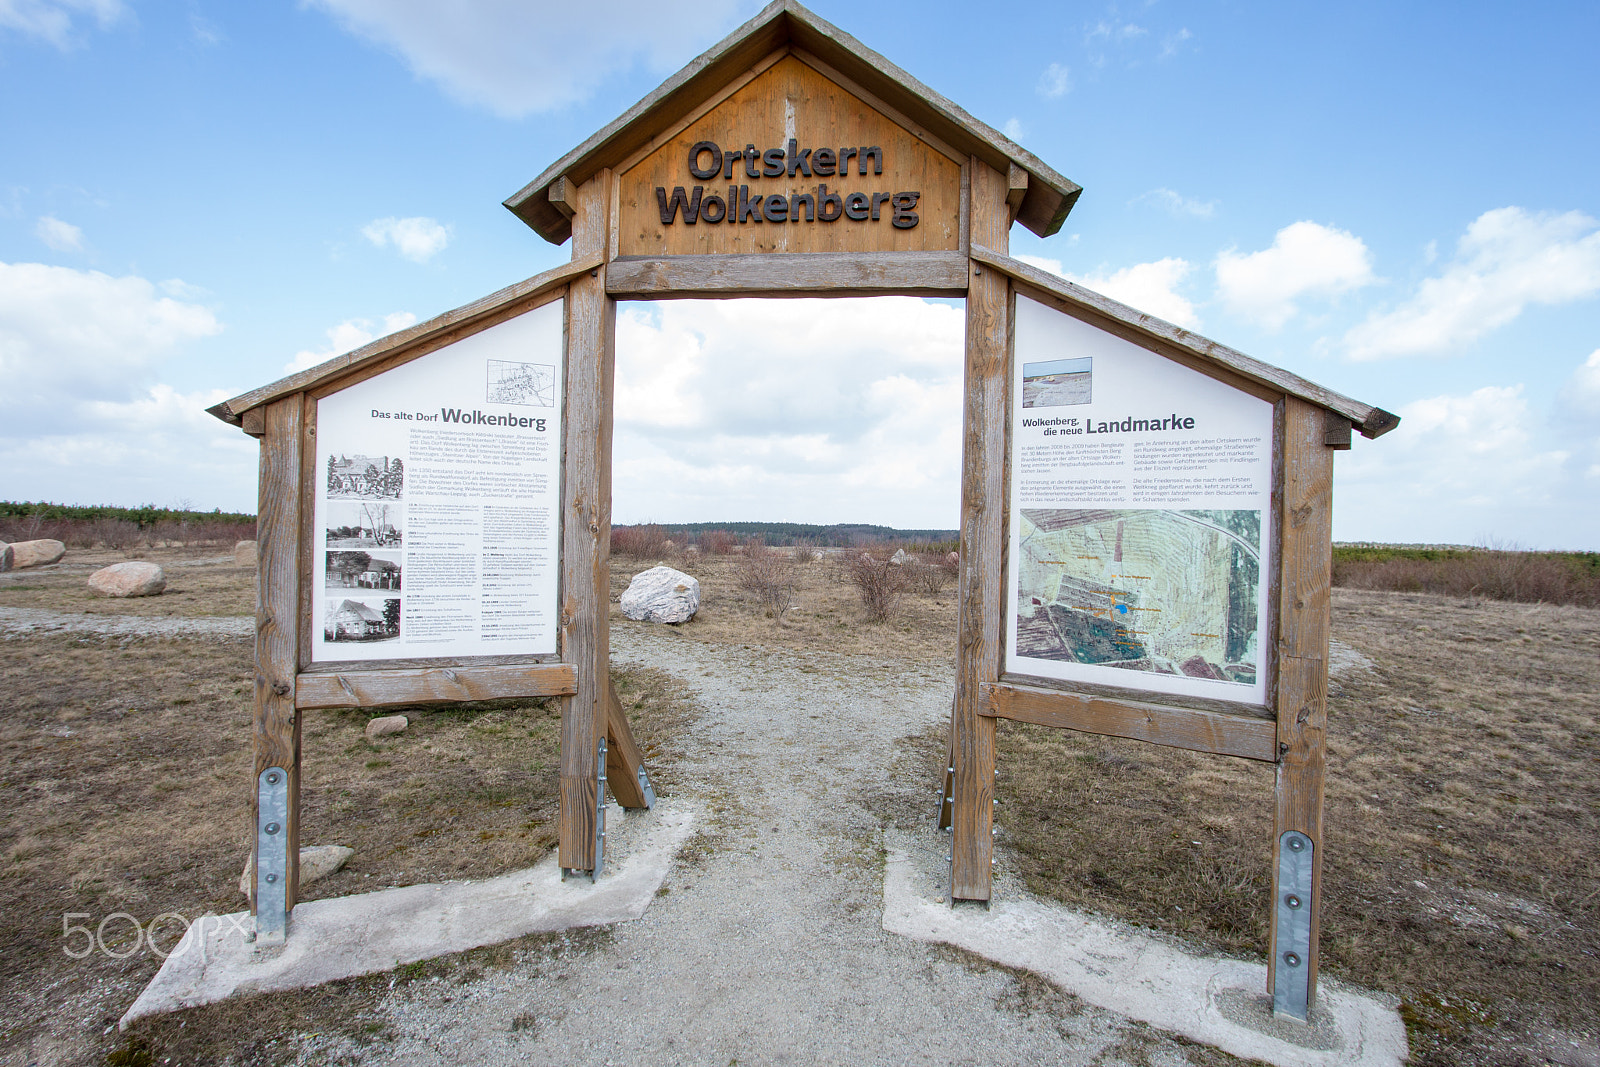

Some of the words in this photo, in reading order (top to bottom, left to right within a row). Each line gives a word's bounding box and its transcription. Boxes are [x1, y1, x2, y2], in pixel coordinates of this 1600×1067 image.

[688, 138, 882, 180] Ortskern
[656, 184, 920, 229] Wolkenberg
[371, 410, 391, 419] Das
[394, 412, 413, 420] alte
[416, 412, 438, 422] Dorf
[441, 408, 547, 432] Wolkenberg
[1022, 418, 1080, 427] Wolkenberg,
[1044, 428, 1057, 436] die
[1086, 414, 1195, 434] Landmarke
